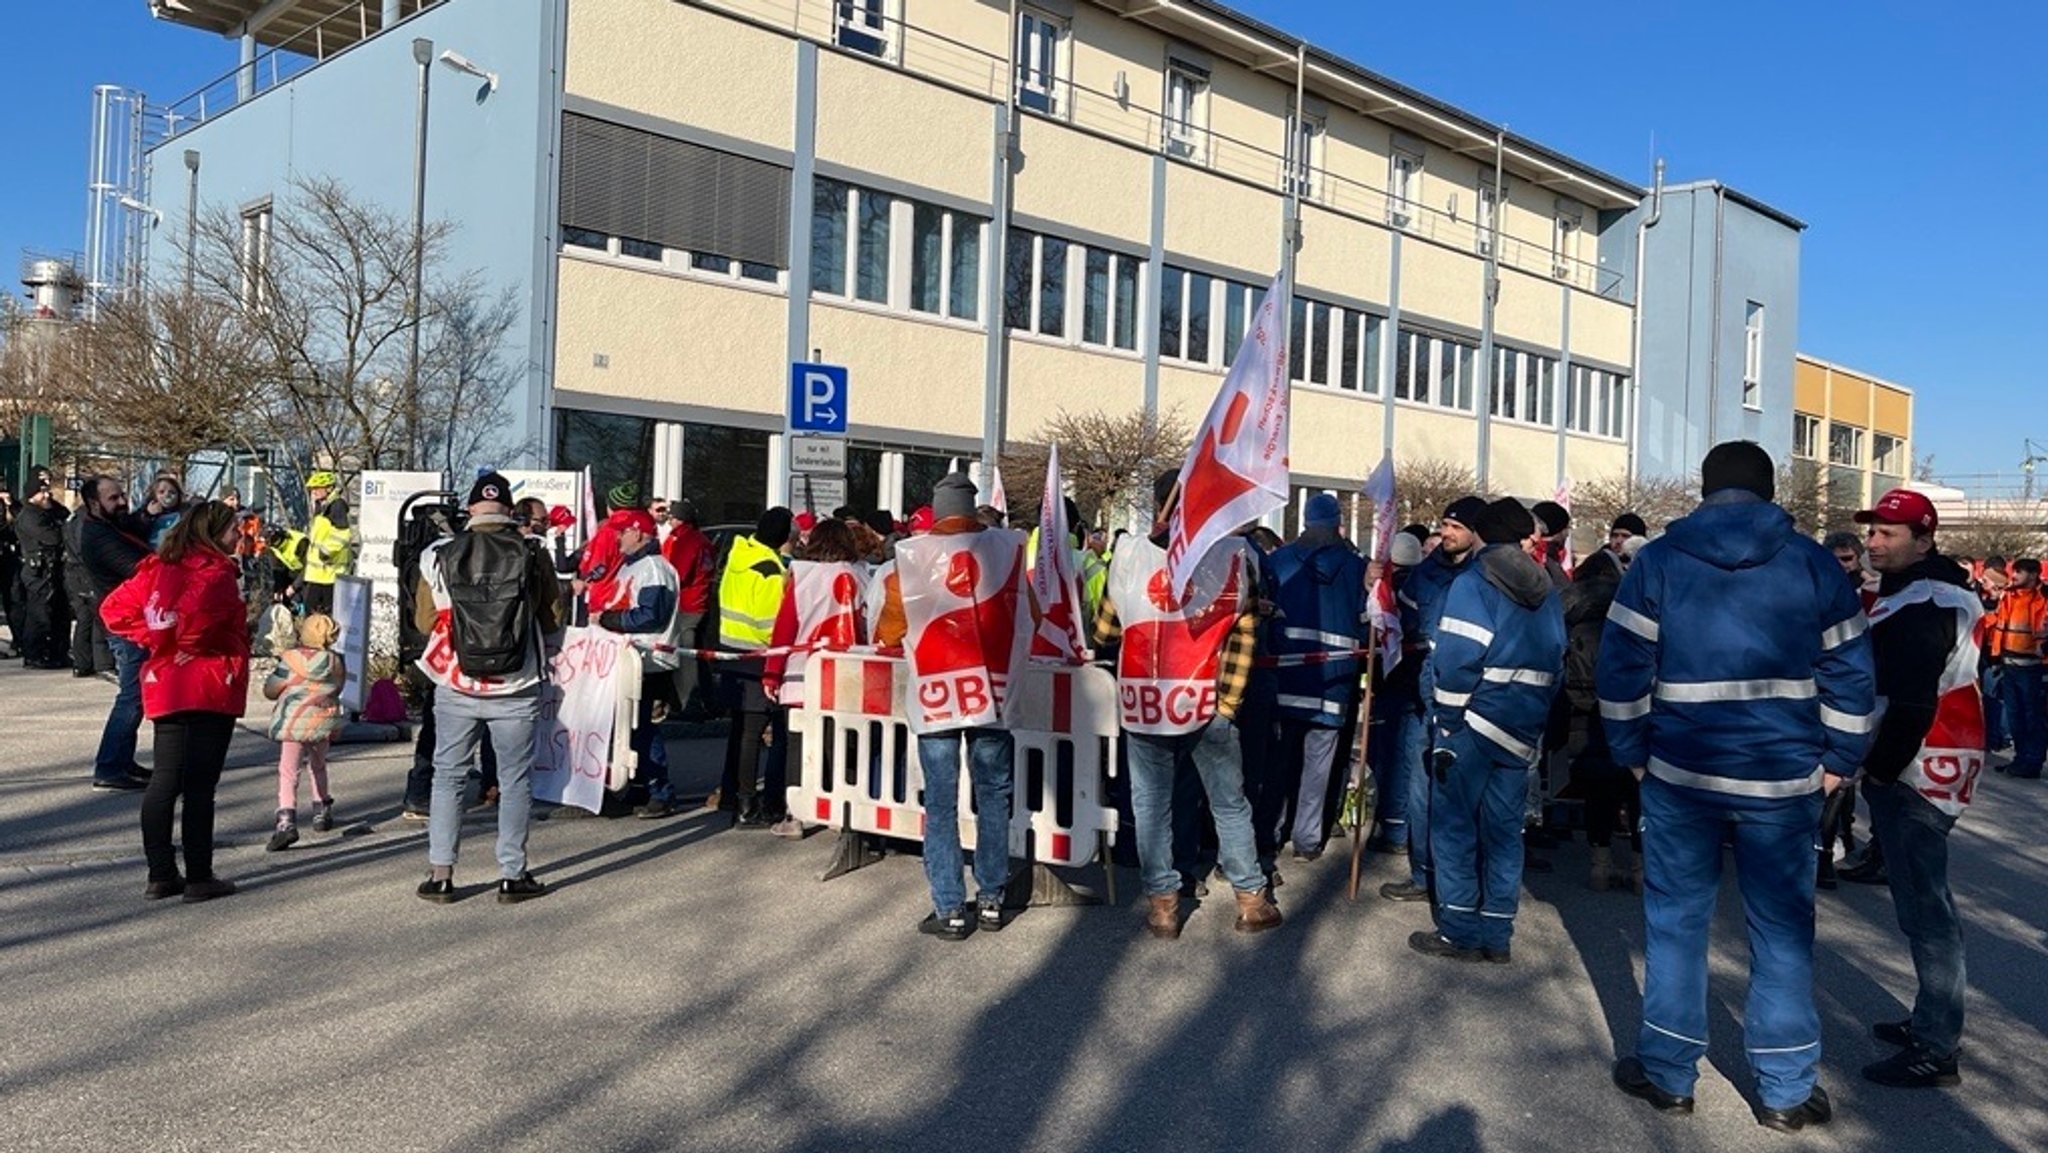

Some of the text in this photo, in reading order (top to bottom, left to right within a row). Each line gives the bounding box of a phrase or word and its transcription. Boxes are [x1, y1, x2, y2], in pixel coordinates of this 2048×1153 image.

[804, 372, 835, 422] P
[1139, 685, 1216, 726] BCE
[1919, 755, 1961, 801] IG
